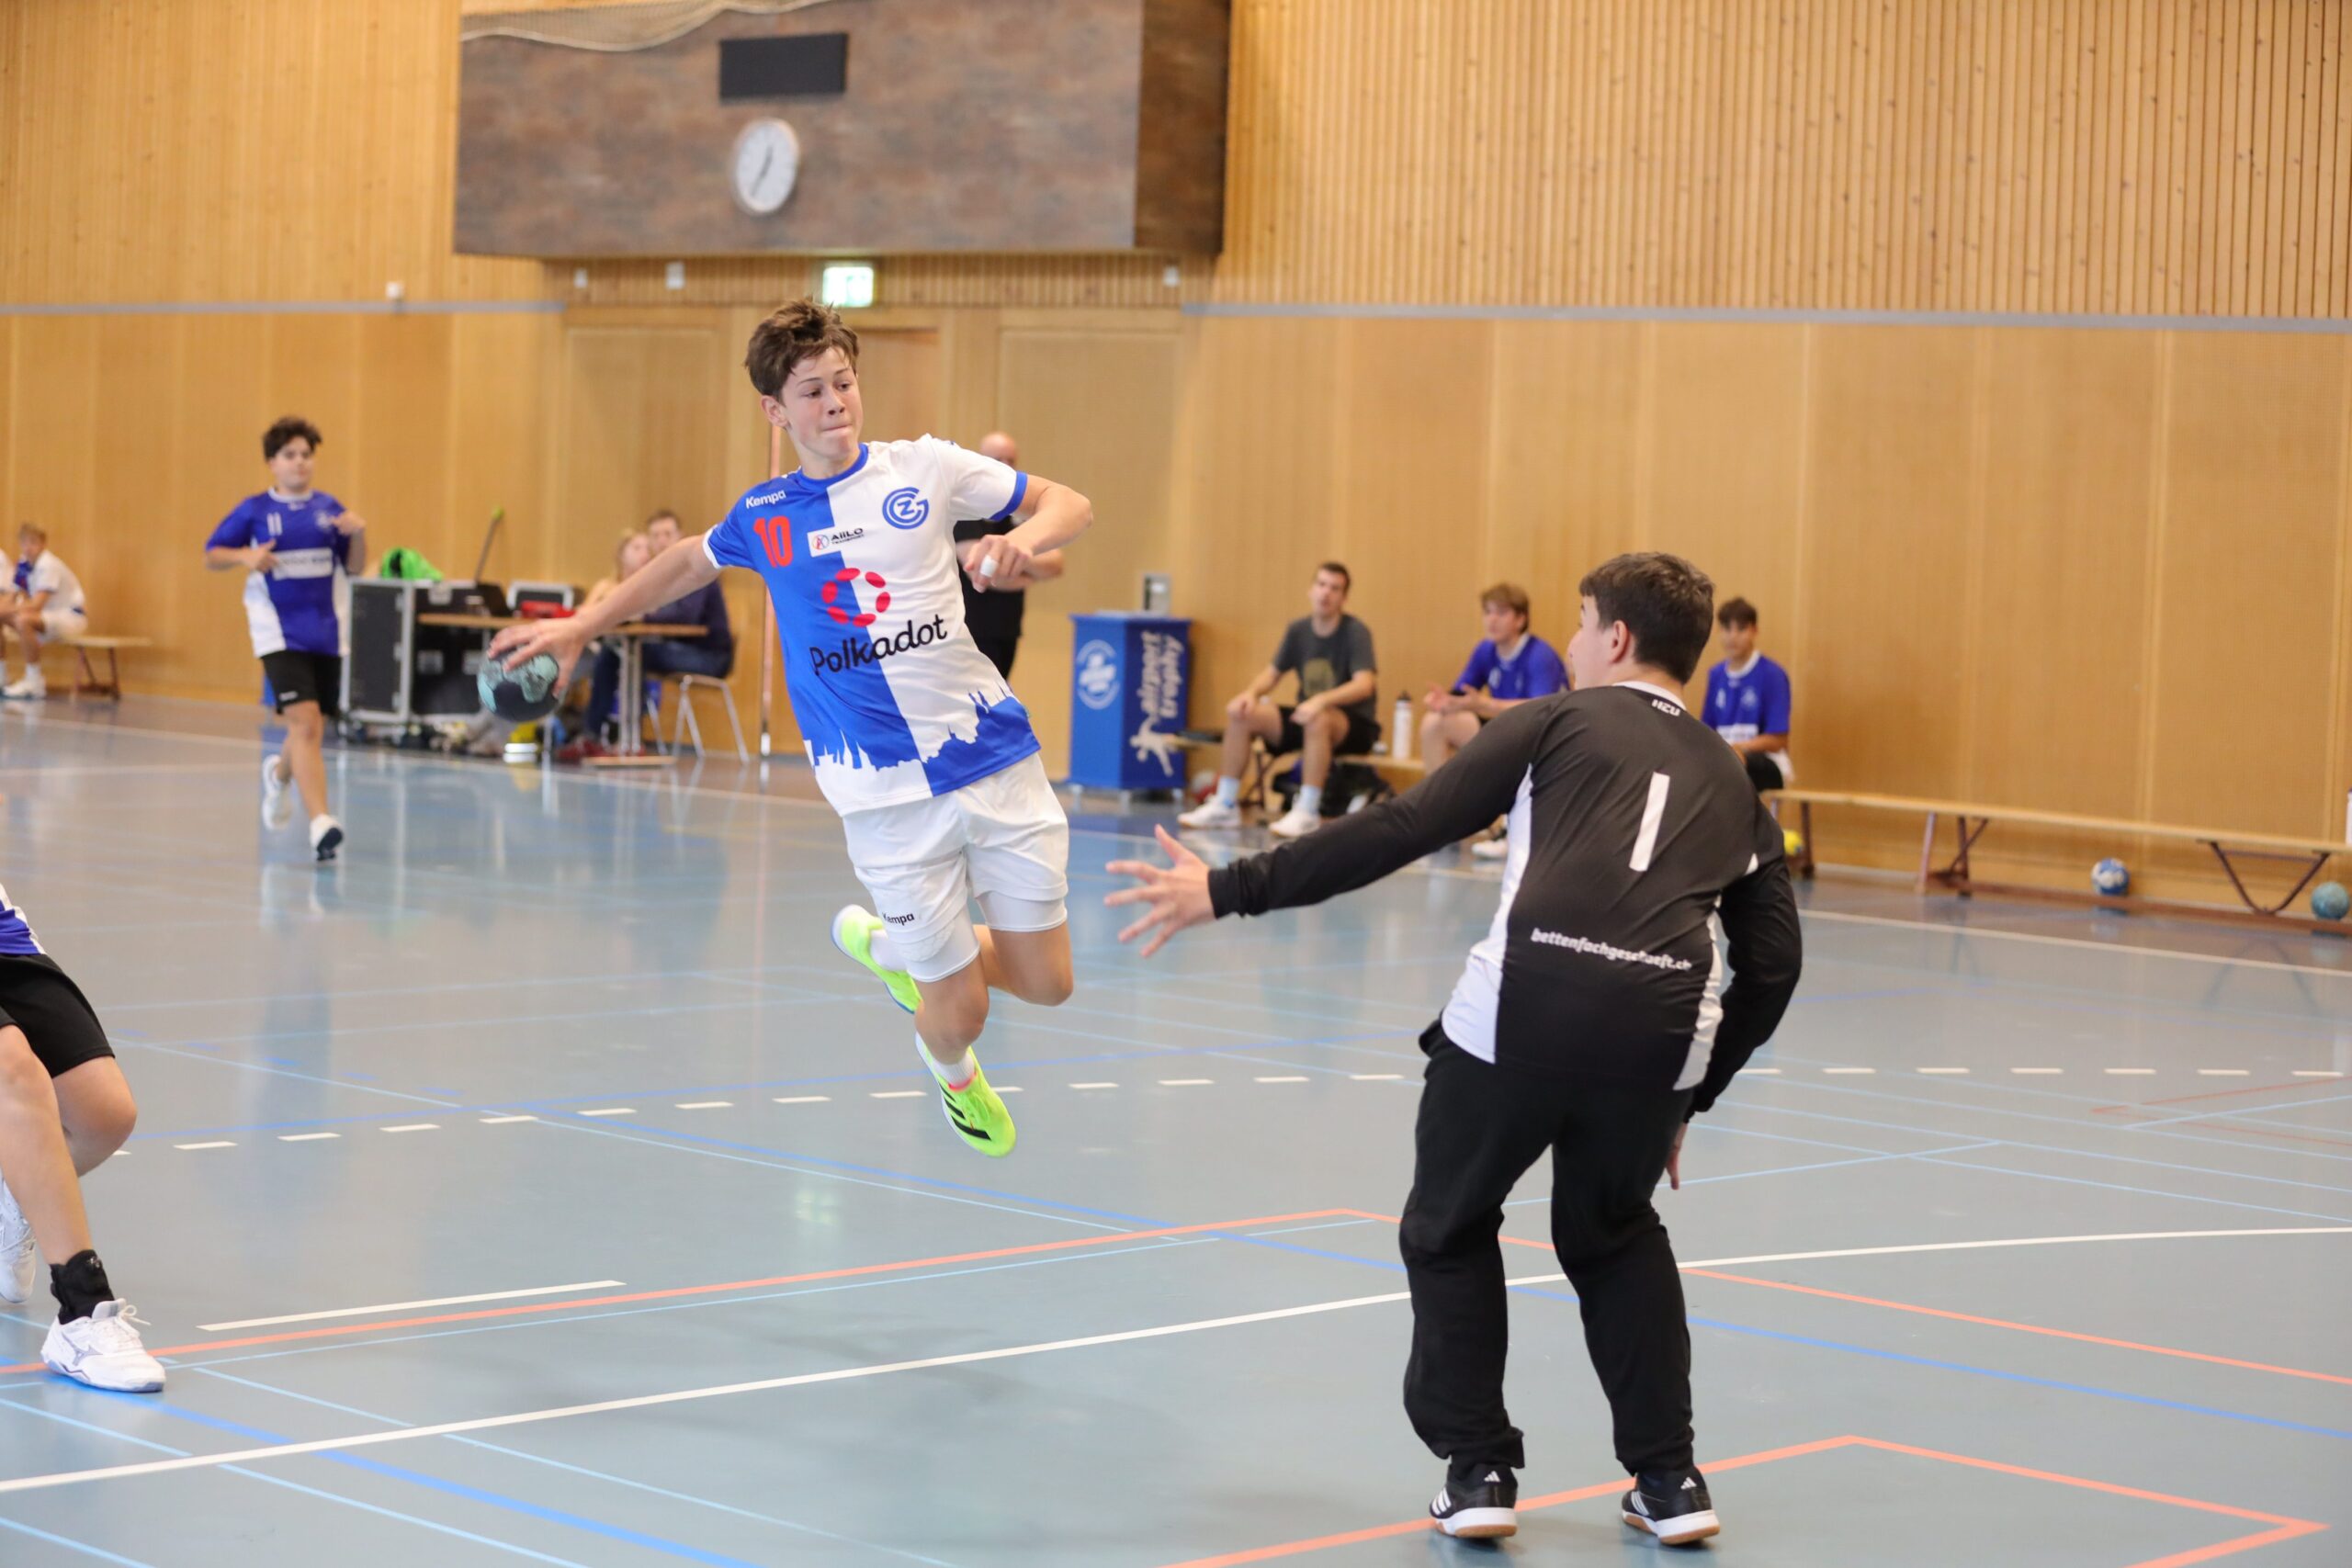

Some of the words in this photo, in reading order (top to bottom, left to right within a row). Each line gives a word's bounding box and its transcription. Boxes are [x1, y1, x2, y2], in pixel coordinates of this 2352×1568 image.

[745, 490, 786, 509] Kempa
[266, 512, 283, 536] 11
[752, 515, 794, 569] 10
[809, 614, 947, 676] Polkadot
[1629, 772, 1670, 871] 1
[1531, 928, 1692, 970] bettenfachgeschaeft.ch
